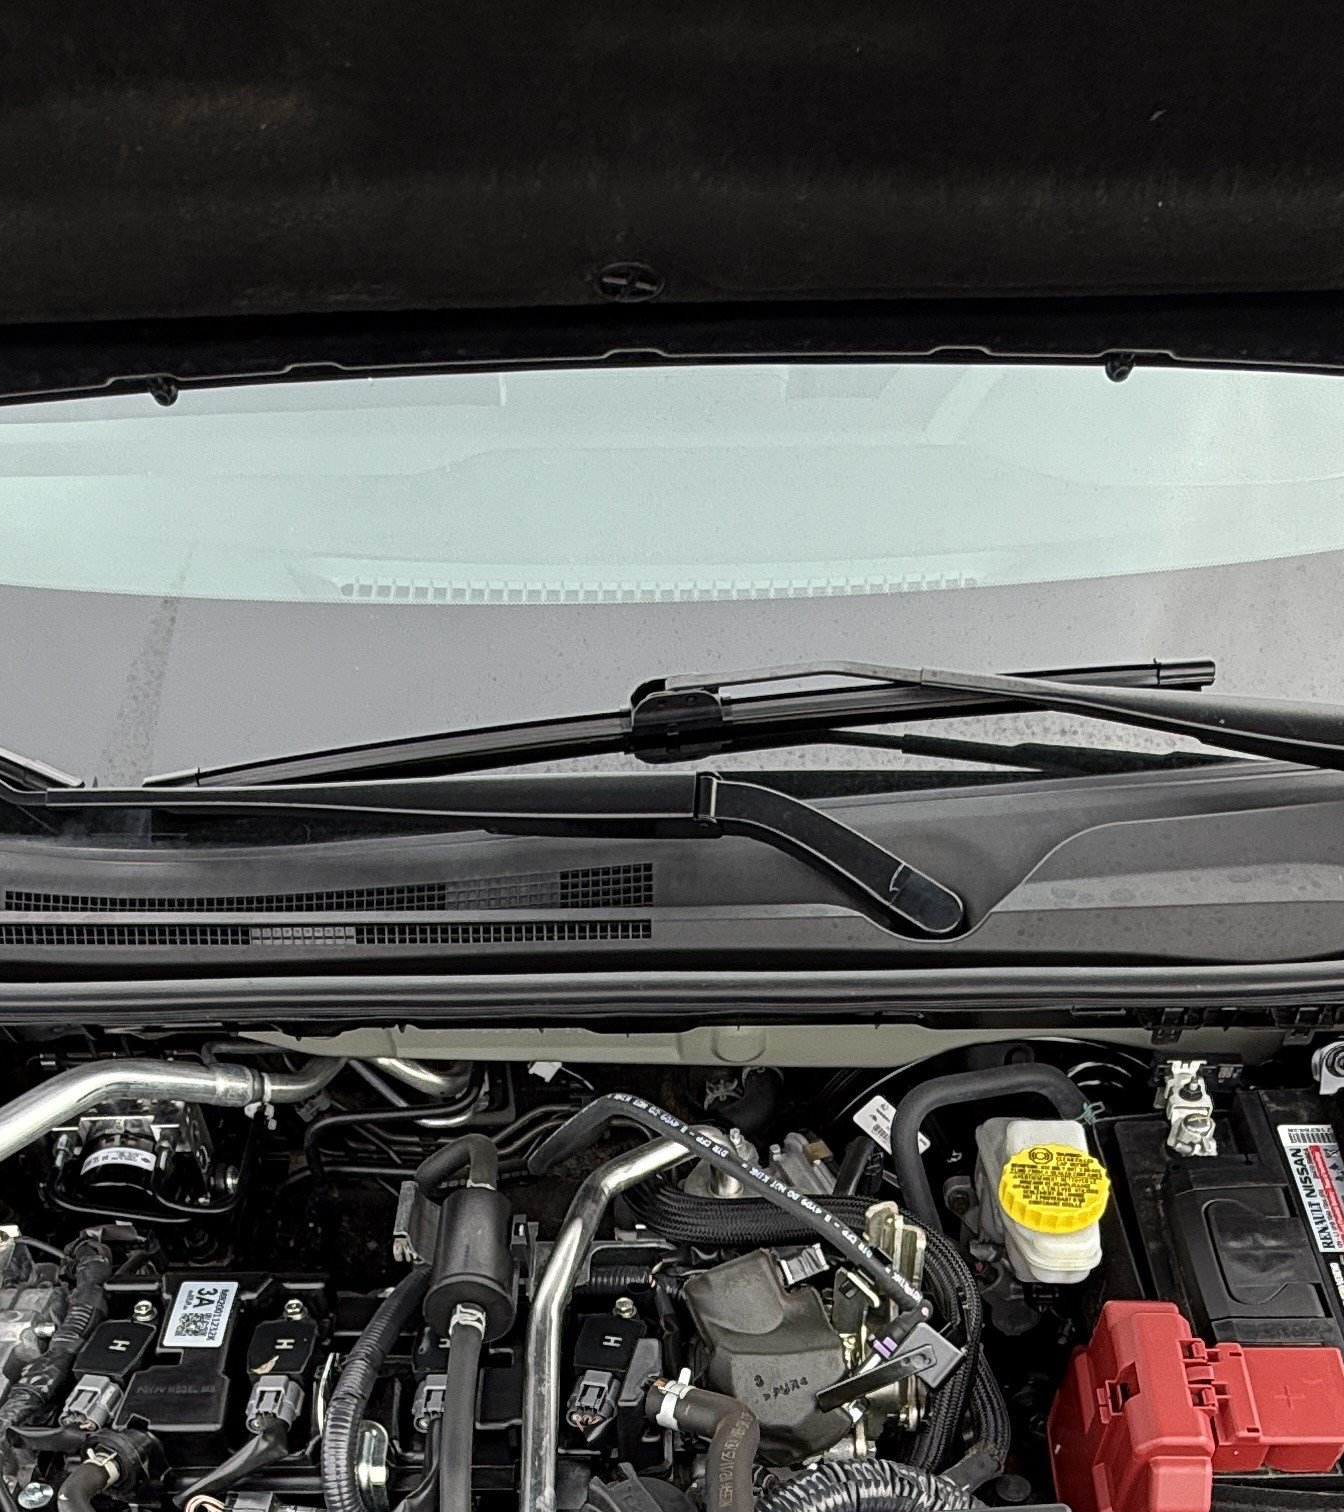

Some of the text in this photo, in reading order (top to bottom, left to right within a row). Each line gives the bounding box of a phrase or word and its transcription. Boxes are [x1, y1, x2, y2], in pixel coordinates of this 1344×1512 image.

[1289, 1147, 1318, 1198] NISSAN
[1308, 1201, 1335, 1249] RENAULT
[193, 1288, 218, 1308] 3A
